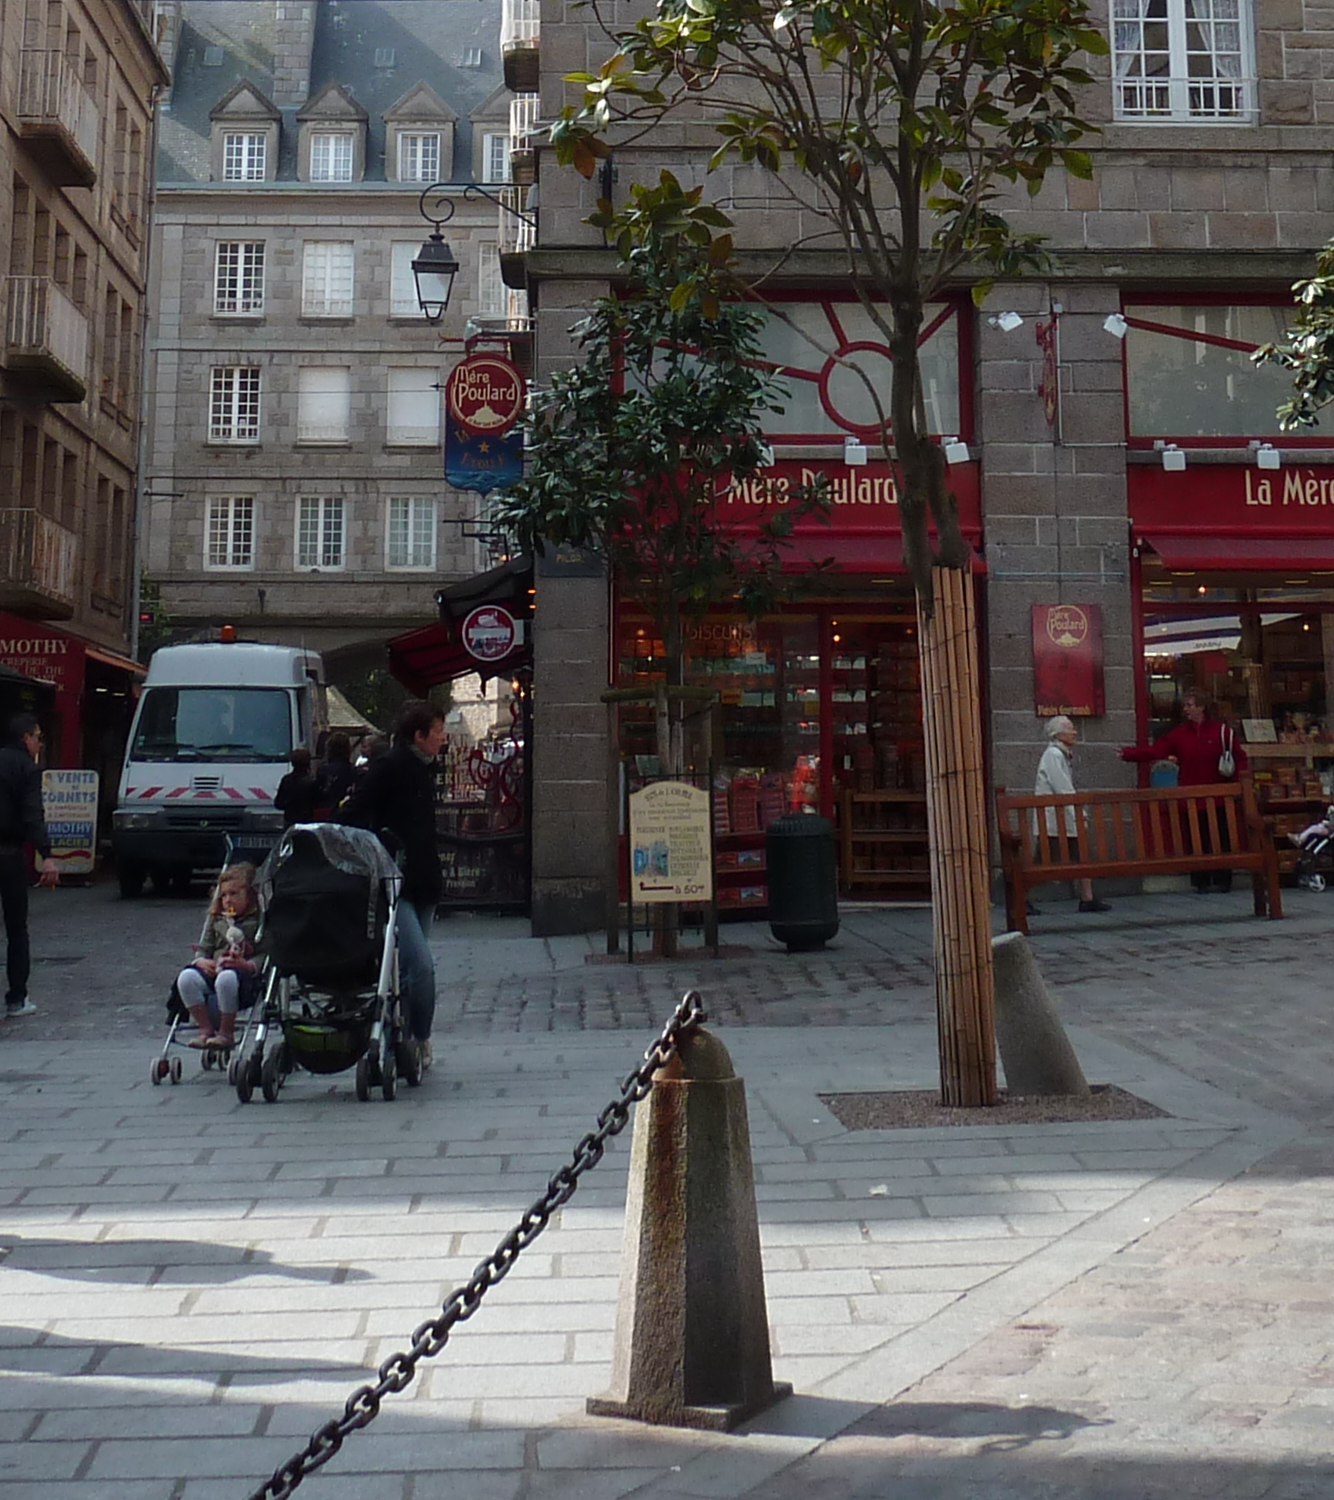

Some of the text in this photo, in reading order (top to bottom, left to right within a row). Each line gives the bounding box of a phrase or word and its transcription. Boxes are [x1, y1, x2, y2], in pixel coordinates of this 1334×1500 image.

[455, 366, 489, 387] Mère
[459, 383, 516, 408] Poulard
[1245, 469, 1272, 506] La
[1050, 619, 1085, 634] Poulard
[57, 773, 95, 784] VENTE
